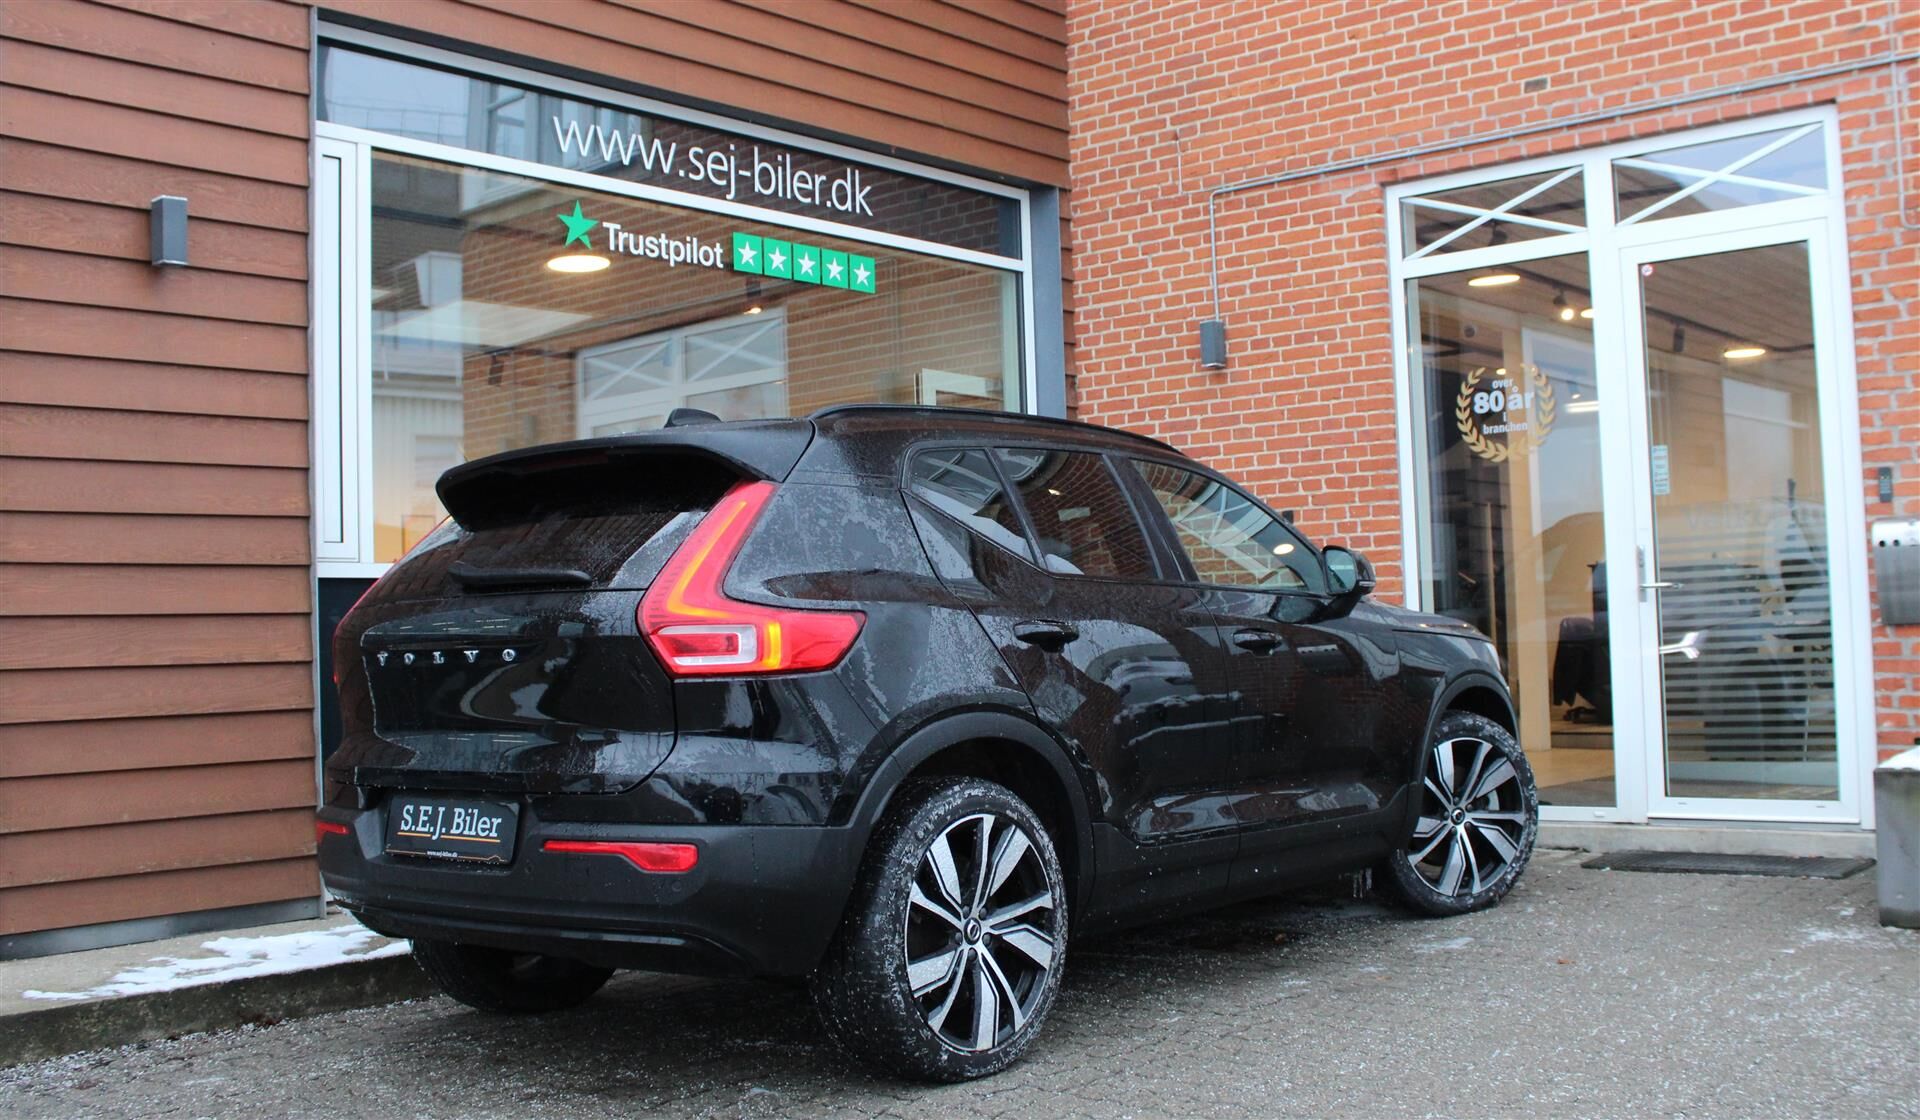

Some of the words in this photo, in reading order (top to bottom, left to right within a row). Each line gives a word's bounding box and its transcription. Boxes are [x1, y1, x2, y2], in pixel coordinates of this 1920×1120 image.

[553, 115, 874, 217] www.sej-biler.dk
[602, 221, 724, 269] Trustpilot
[1492, 378, 1514, 389] over
[1474, 390, 1504, 414] 80
[1507, 386, 1534, 410] år
[1483, 422, 1528, 434] branchen
[377, 648, 516, 666] VOLVO
[400, 804, 447, 841] S.E.J.
[450, 807, 502, 838] Biler
